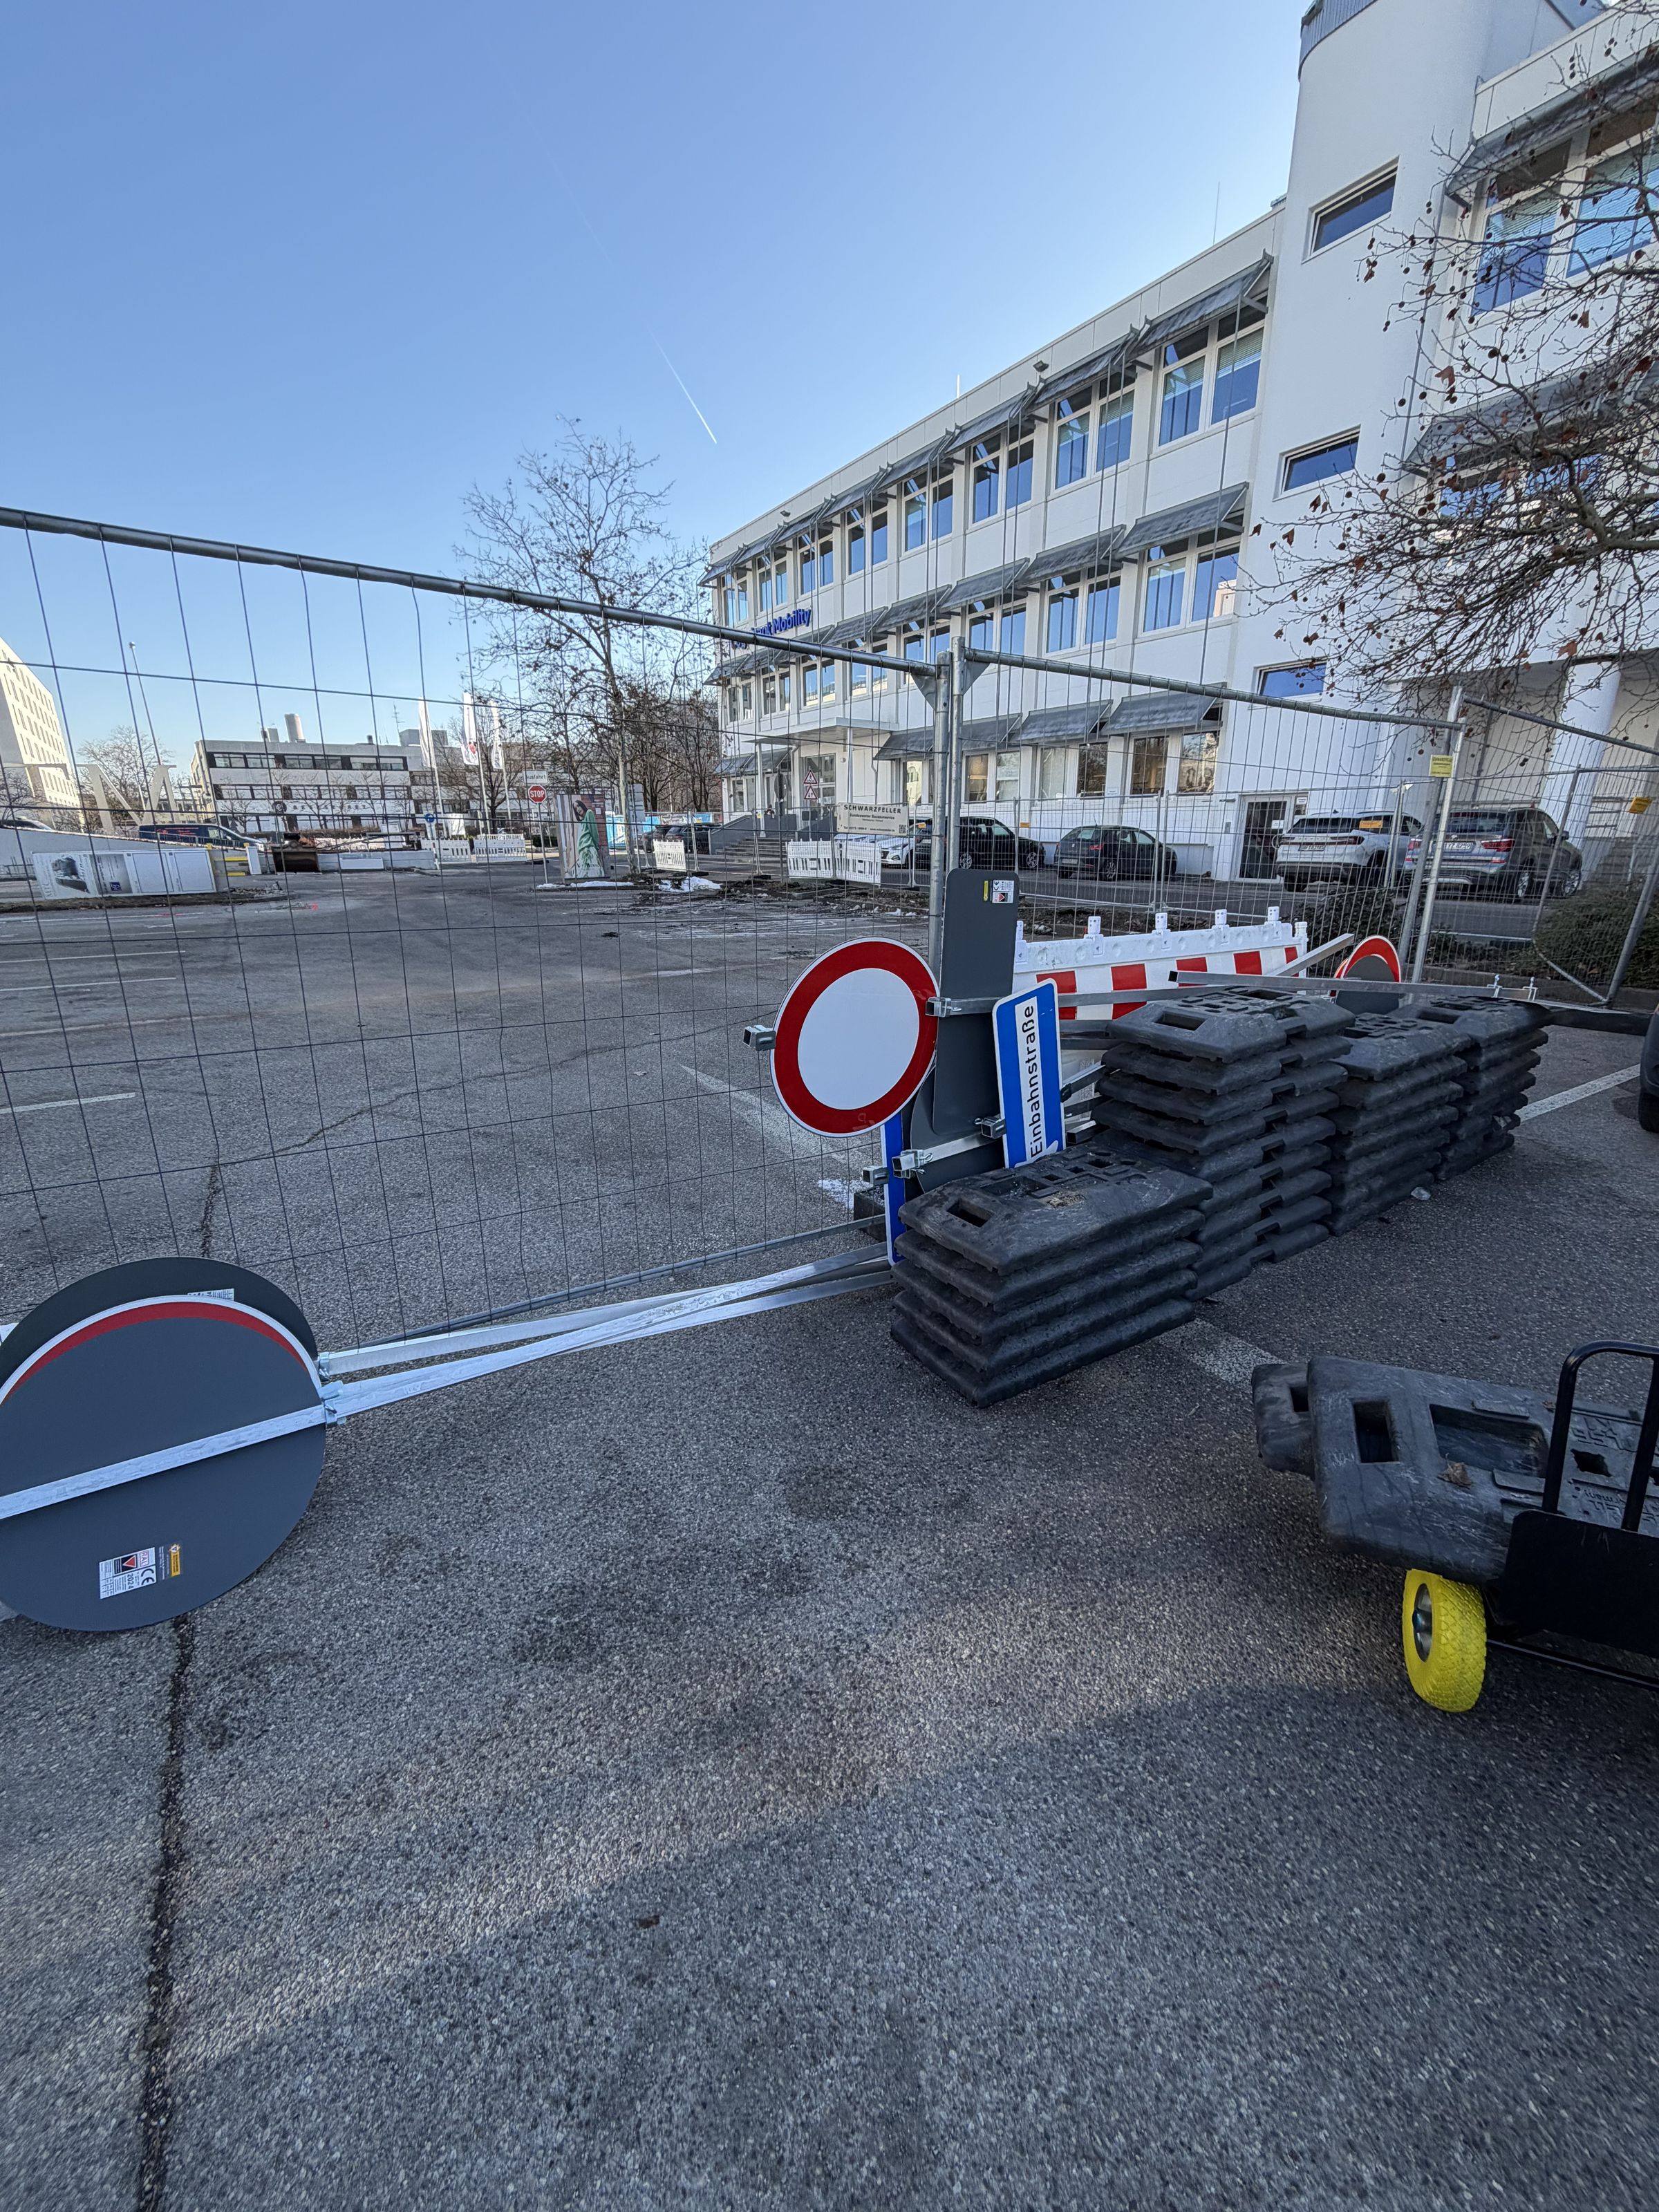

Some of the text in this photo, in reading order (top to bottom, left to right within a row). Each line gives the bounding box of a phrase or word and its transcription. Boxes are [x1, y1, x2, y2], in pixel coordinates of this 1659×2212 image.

[772, 608, 812, 634] Mobility
[843, 804, 901, 814] SCHWARZFELLER
[1022, 1005, 1043, 1159] Einbahnstraße
[140, 1550, 149, 1566] RAL
